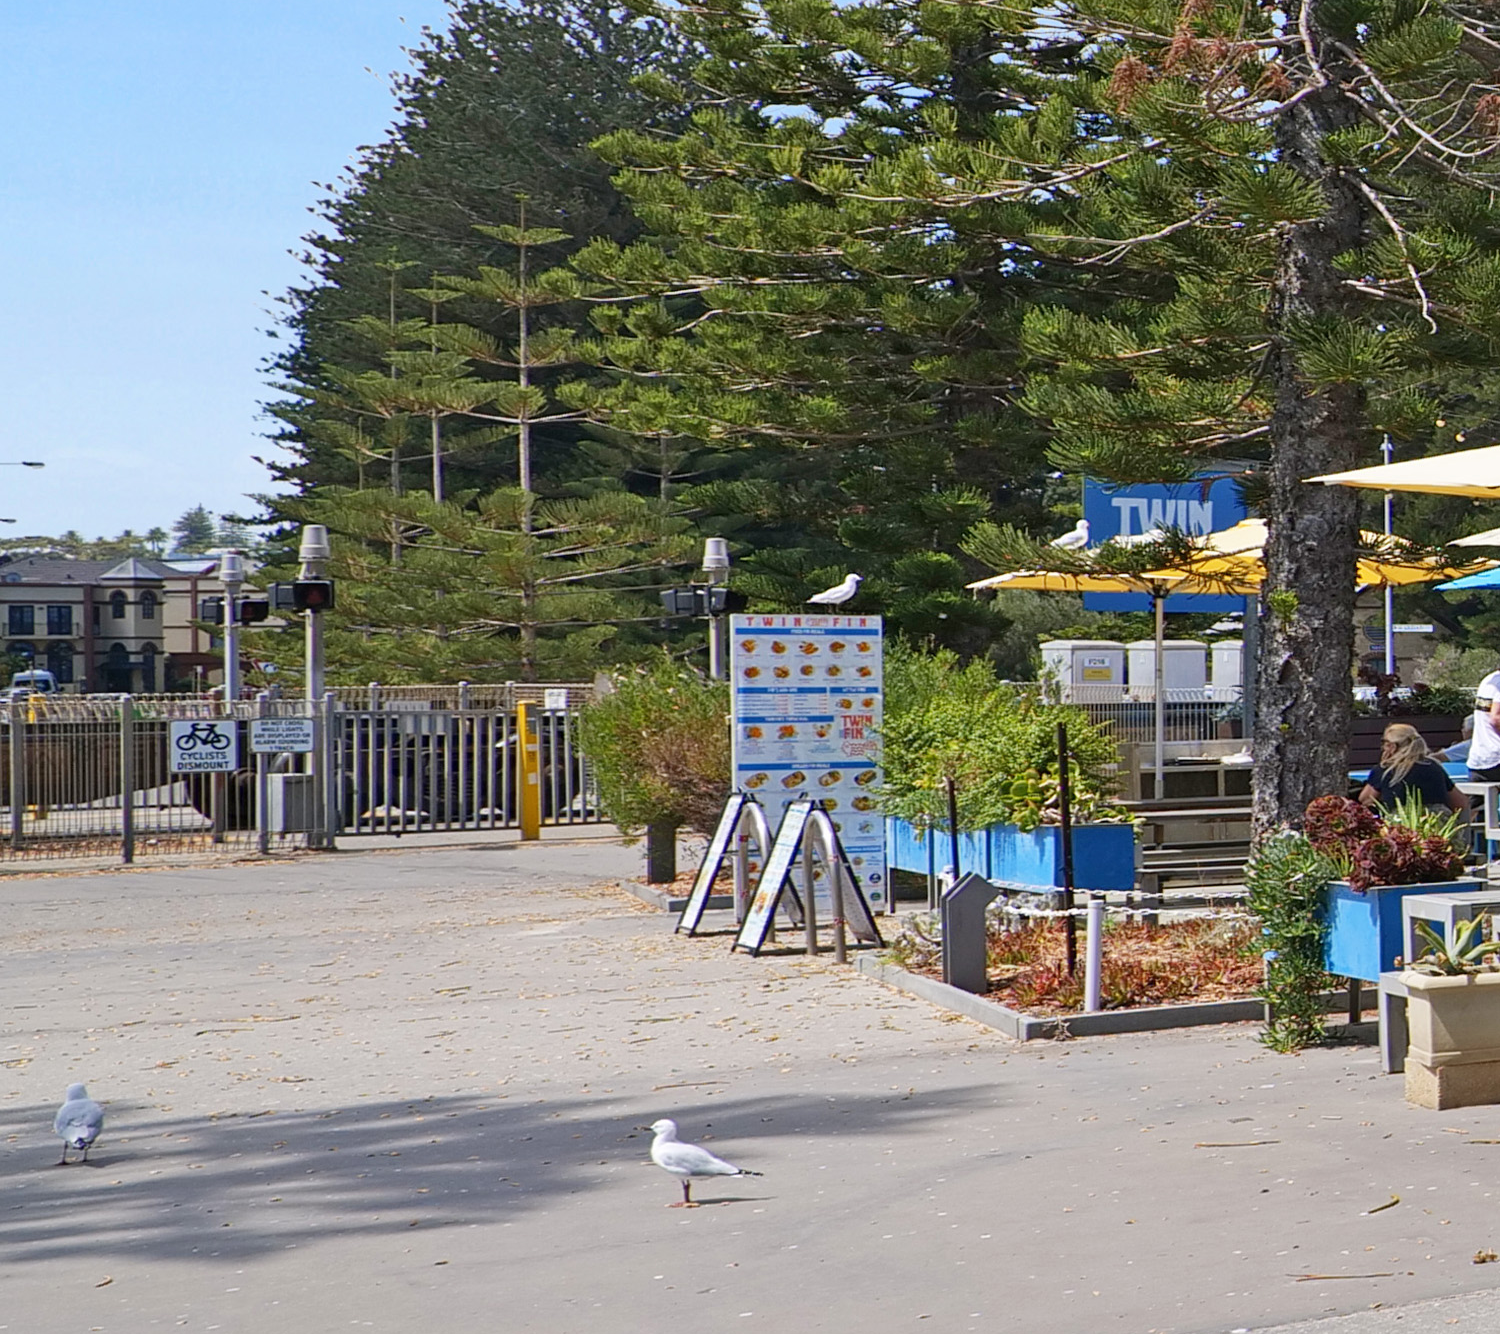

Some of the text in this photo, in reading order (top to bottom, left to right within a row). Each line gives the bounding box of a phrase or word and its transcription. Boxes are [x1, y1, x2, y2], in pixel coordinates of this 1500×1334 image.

[1111, 497, 1213, 535] TWIN
[746, 617, 802, 627] TWIN
[832, 617, 867, 627] FIN
[841, 714, 872, 727] TWIN
[844, 728, 864, 739] FIN
[180, 752, 227, 760] CYCLISTS
[177, 761, 229, 770] DISMOUNT
